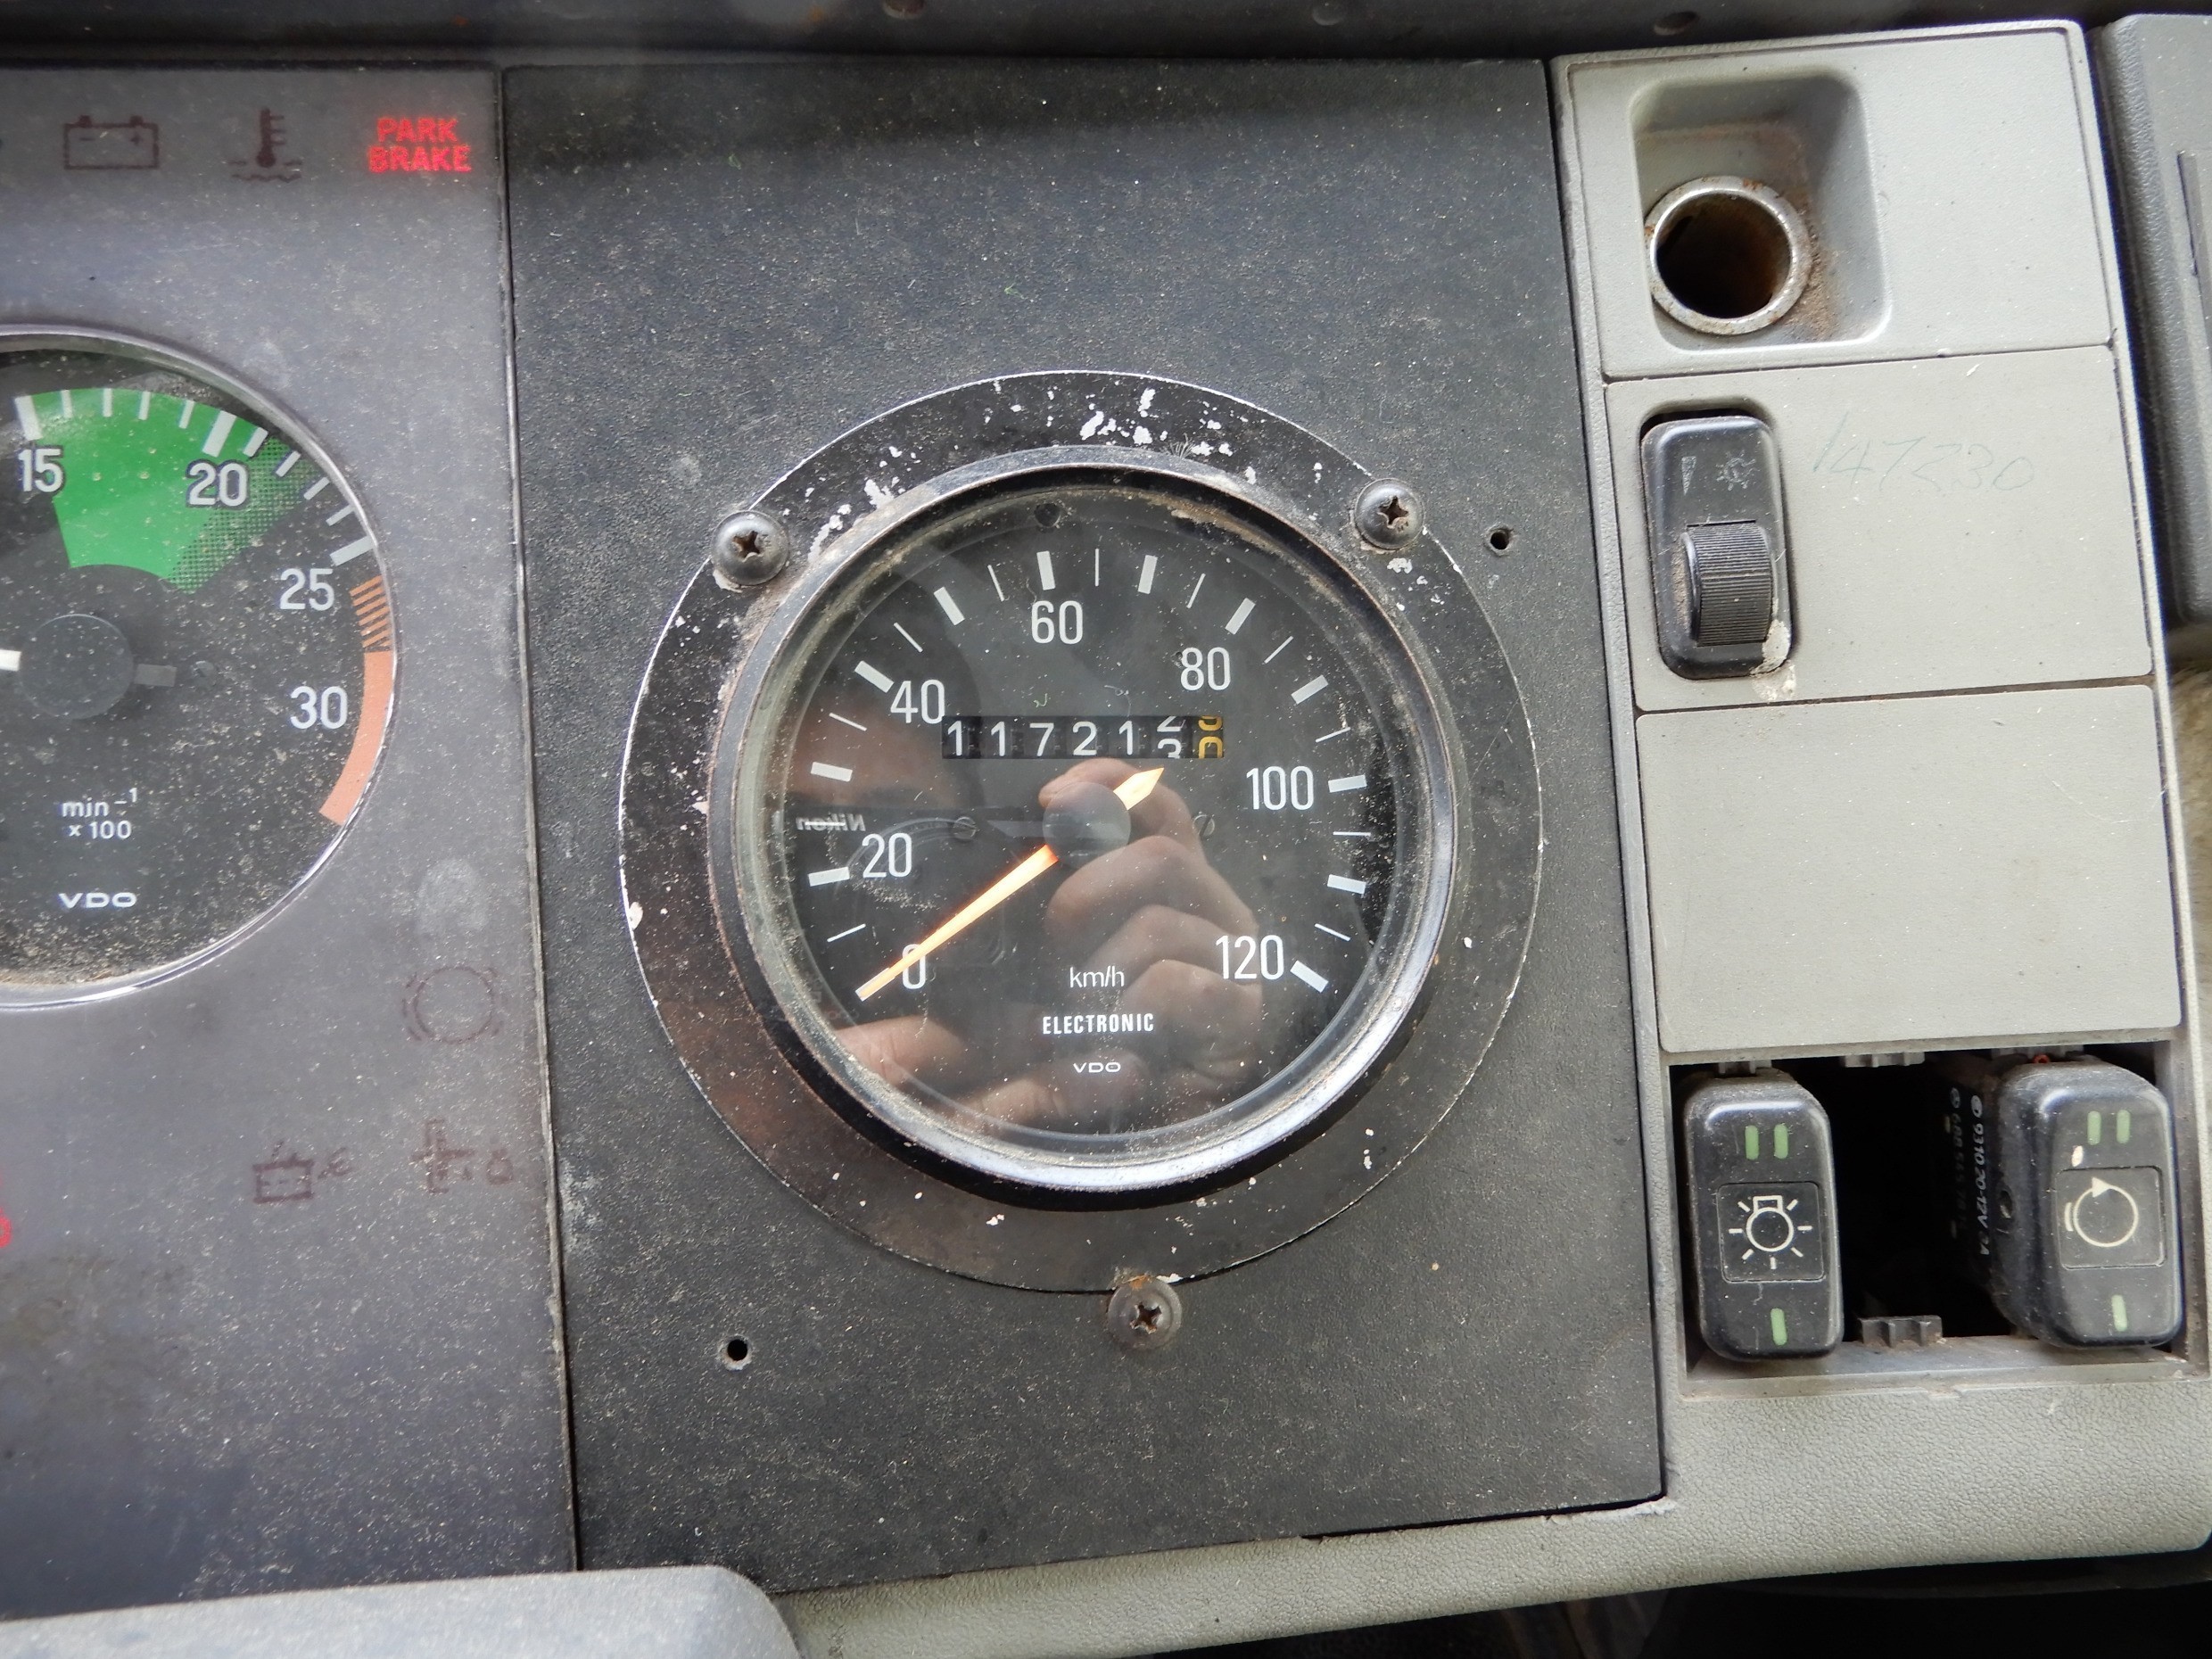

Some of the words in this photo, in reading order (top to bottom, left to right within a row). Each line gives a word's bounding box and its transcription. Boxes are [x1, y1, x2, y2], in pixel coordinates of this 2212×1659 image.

[376, 116, 459, 143] PARK
[367, 145, 472, 173] BRAKE
[18, 448, 64, 493] 15
[186, 462, 248, 507] 20
[279, 568, 335, 611] 25
[1031, 600, 1084, 645] 60
[1179, 647, 1232, 691] 80
[289, 685, 349, 730] 30
[890, 679, 945, 724] 40
[1246, 765, 1315, 811] 100
[862, 832, 912, 879] 20
[58, 892, 138, 909] VDO
[901, 944, 928, 990] 0
[1069, 965, 1125, 988] km/h
[1215, 934, 1285, 980] 120
[1042, 1012, 1154, 1035] ELECTRONIC
[1072, 1061, 1122, 1074] VDO
